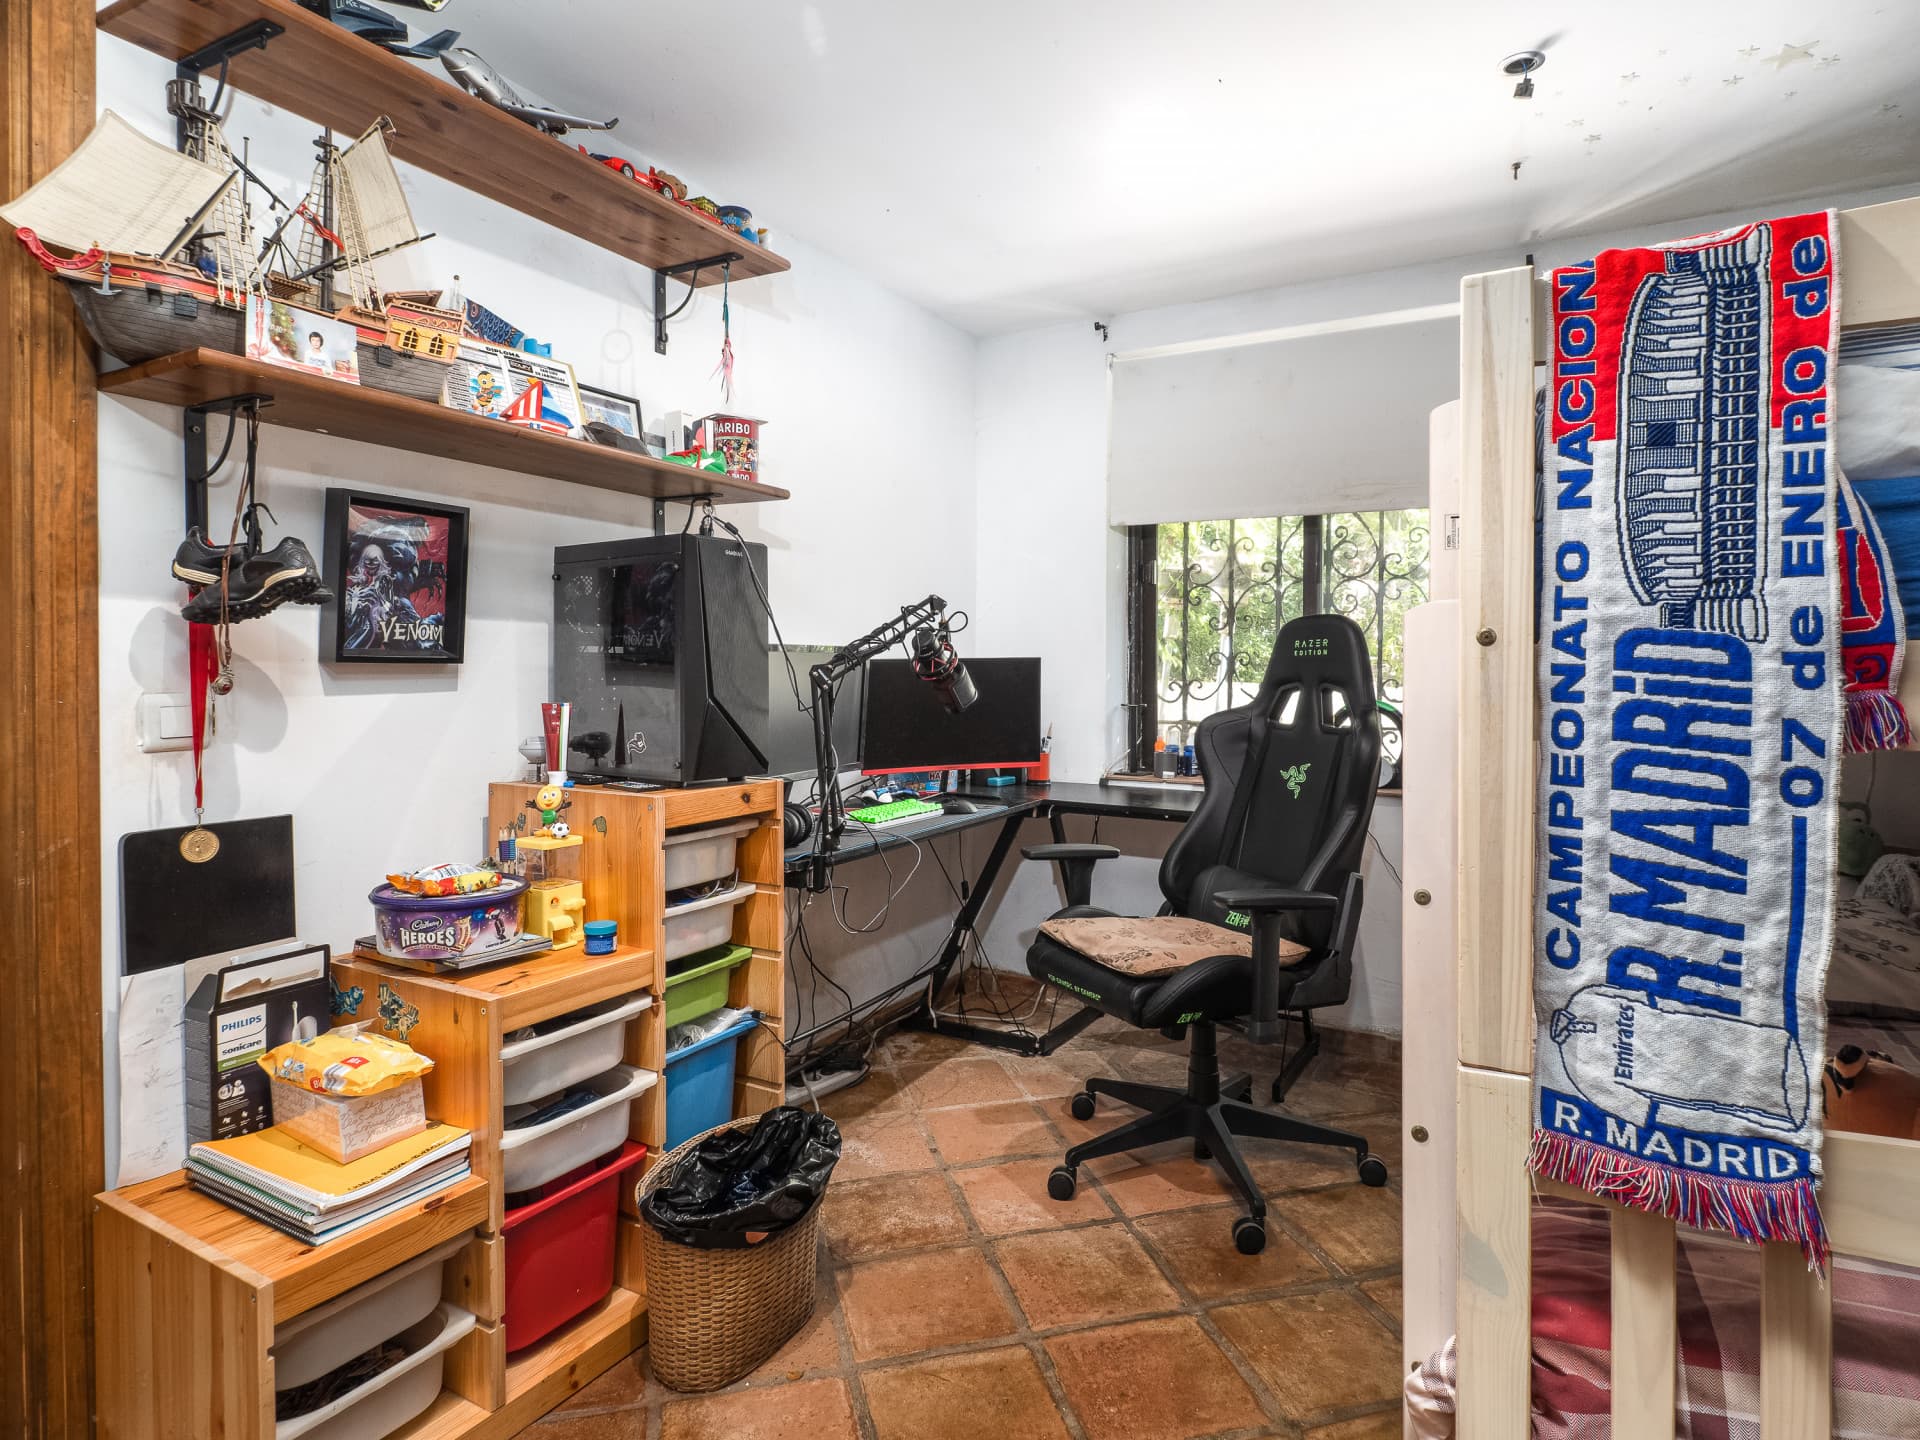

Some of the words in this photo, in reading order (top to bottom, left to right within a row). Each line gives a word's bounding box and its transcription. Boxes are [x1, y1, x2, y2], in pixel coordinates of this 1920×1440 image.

[1783, 234, 1828, 318] de
[1556, 259, 1597, 509] NACION
[715, 422, 750, 435] HARIBO
[1781, 345, 1829, 578] ENERO
[379, 616, 444, 646] VENOM
[1294, 638, 1329, 648] RAZER
[1781, 605, 1825, 690] de
[1546, 541, 1590, 970] CAMPEONATO
[1779, 718, 1826, 808] 07
[400, 926, 456, 947] HEROES
[221, 1014, 262, 1033] PHILIPS
[221, 1038, 262, 1056] sonicare
[1612, 1003, 1635, 1080] Emirates
[1554, 1100, 1592, 1137] R.
[1605, 1116, 1799, 1179] MADRID
